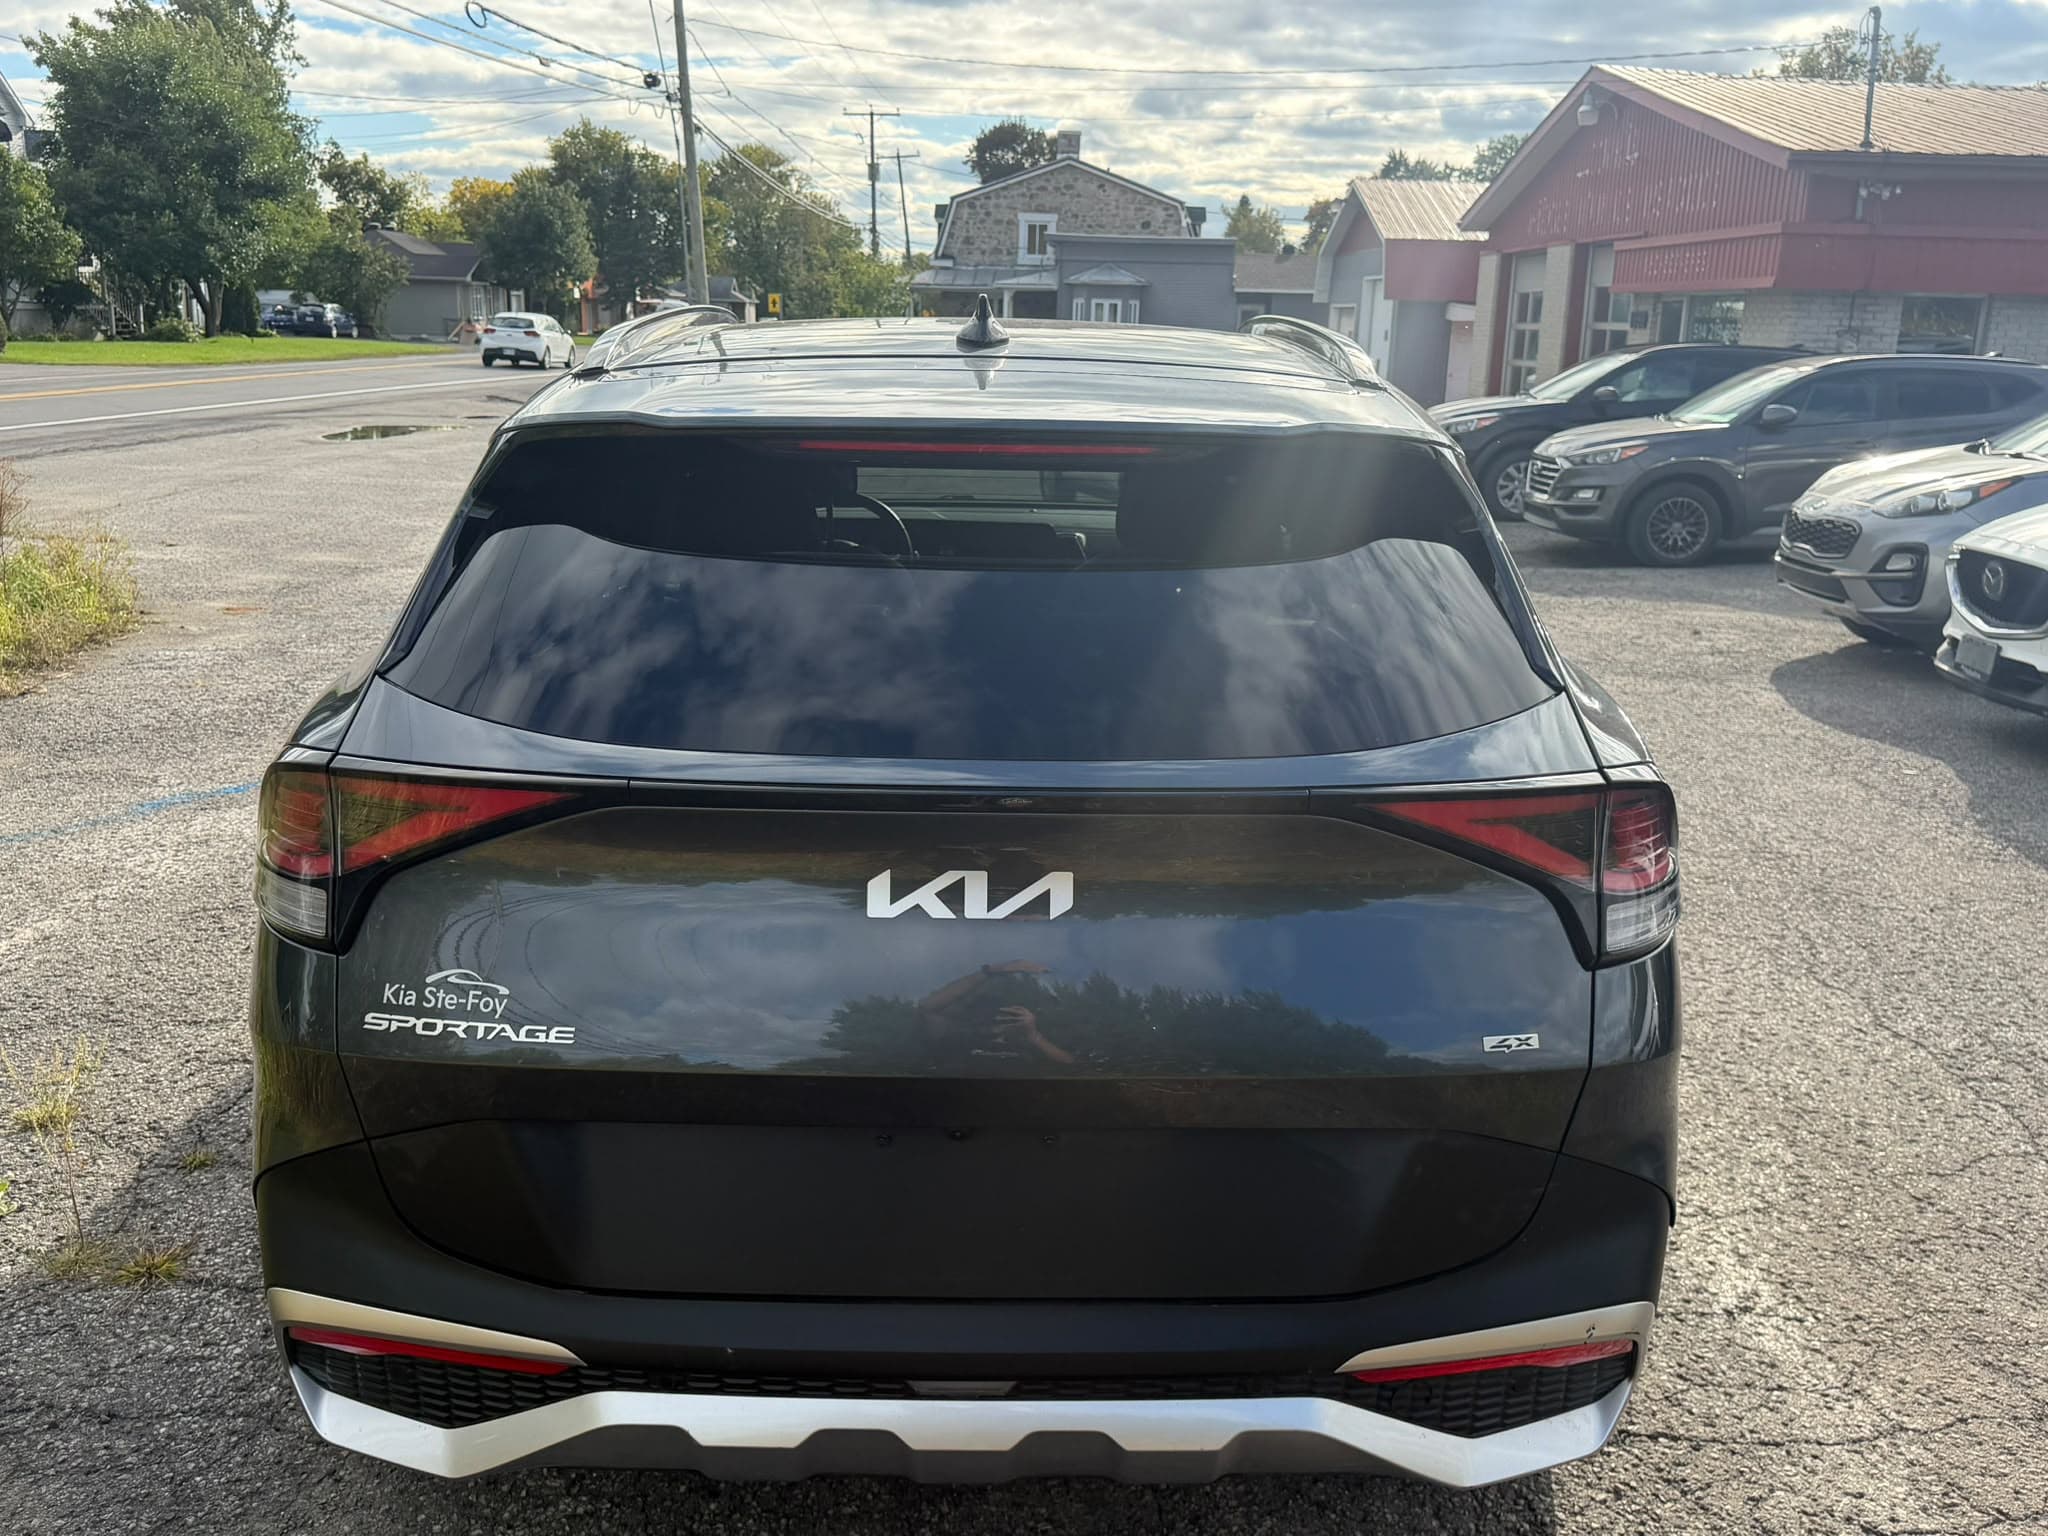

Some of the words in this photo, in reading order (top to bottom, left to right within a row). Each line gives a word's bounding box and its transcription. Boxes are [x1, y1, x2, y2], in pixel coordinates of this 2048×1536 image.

[866, 868, 1075, 920] KIA
[382, 982, 417, 1008] Kia
[422, 986, 508, 1019] Ste-Foy
[362, 1012, 576, 1044] SPORTAGE
